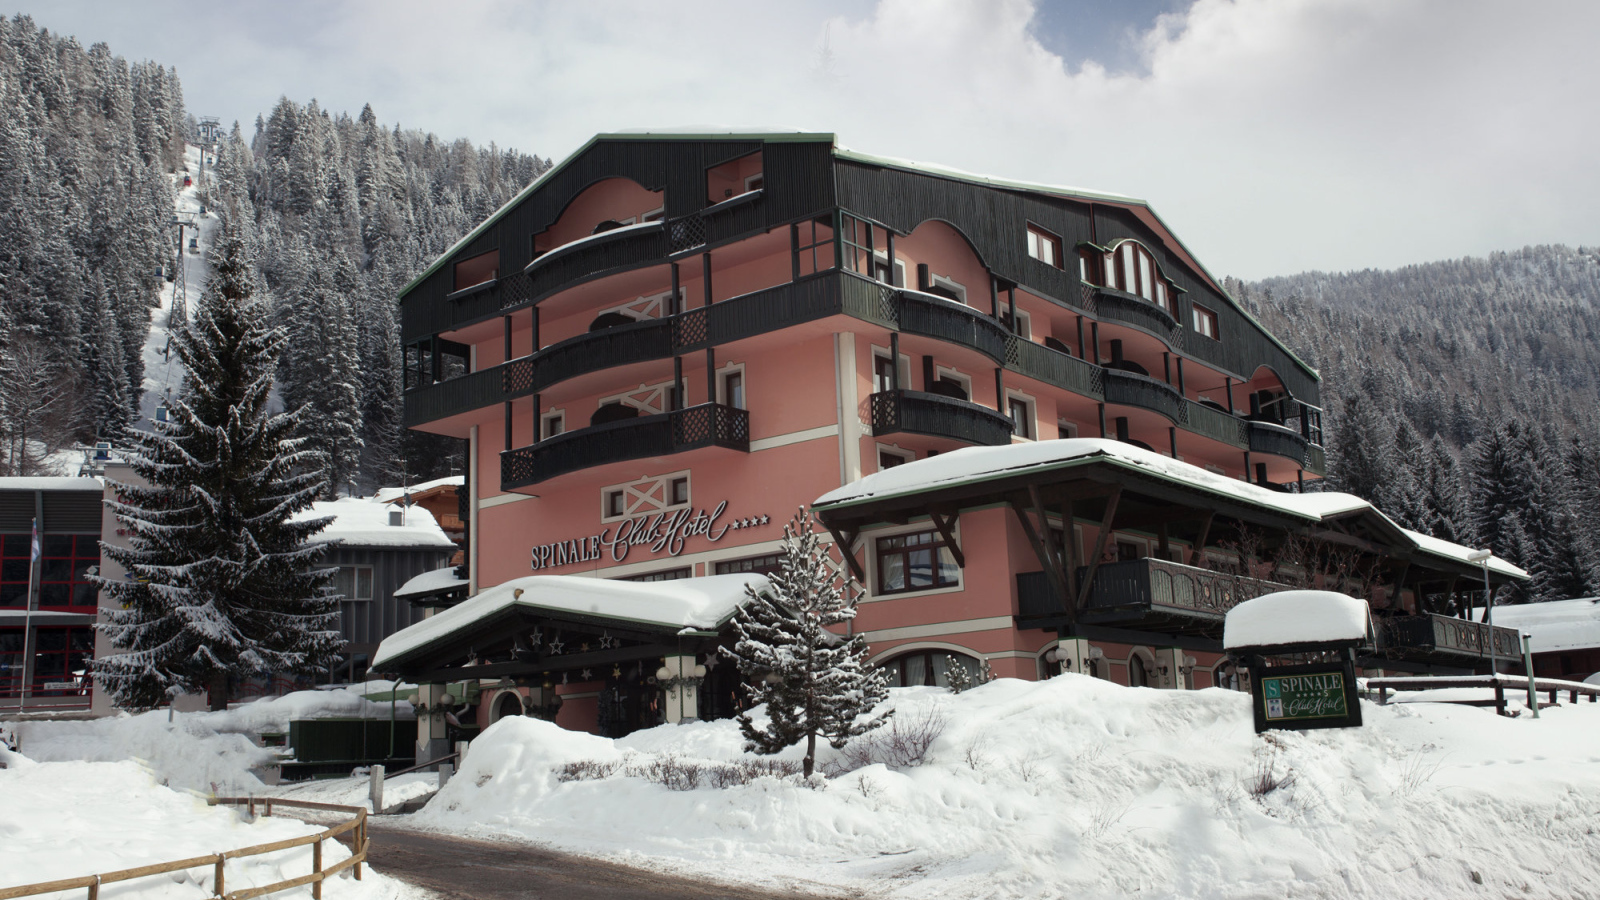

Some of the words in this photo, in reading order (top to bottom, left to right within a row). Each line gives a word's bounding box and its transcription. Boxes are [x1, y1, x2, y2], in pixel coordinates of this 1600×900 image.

[531, 535, 601, 570] SPINALE
[601, 515, 662, 562] Club
[651, 500, 728, 556] Hotel
[1281, 675, 1341, 692] SPINALE
[1283, 698, 1312, 716] Club
[1310, 696, 1344, 715] Hotel
